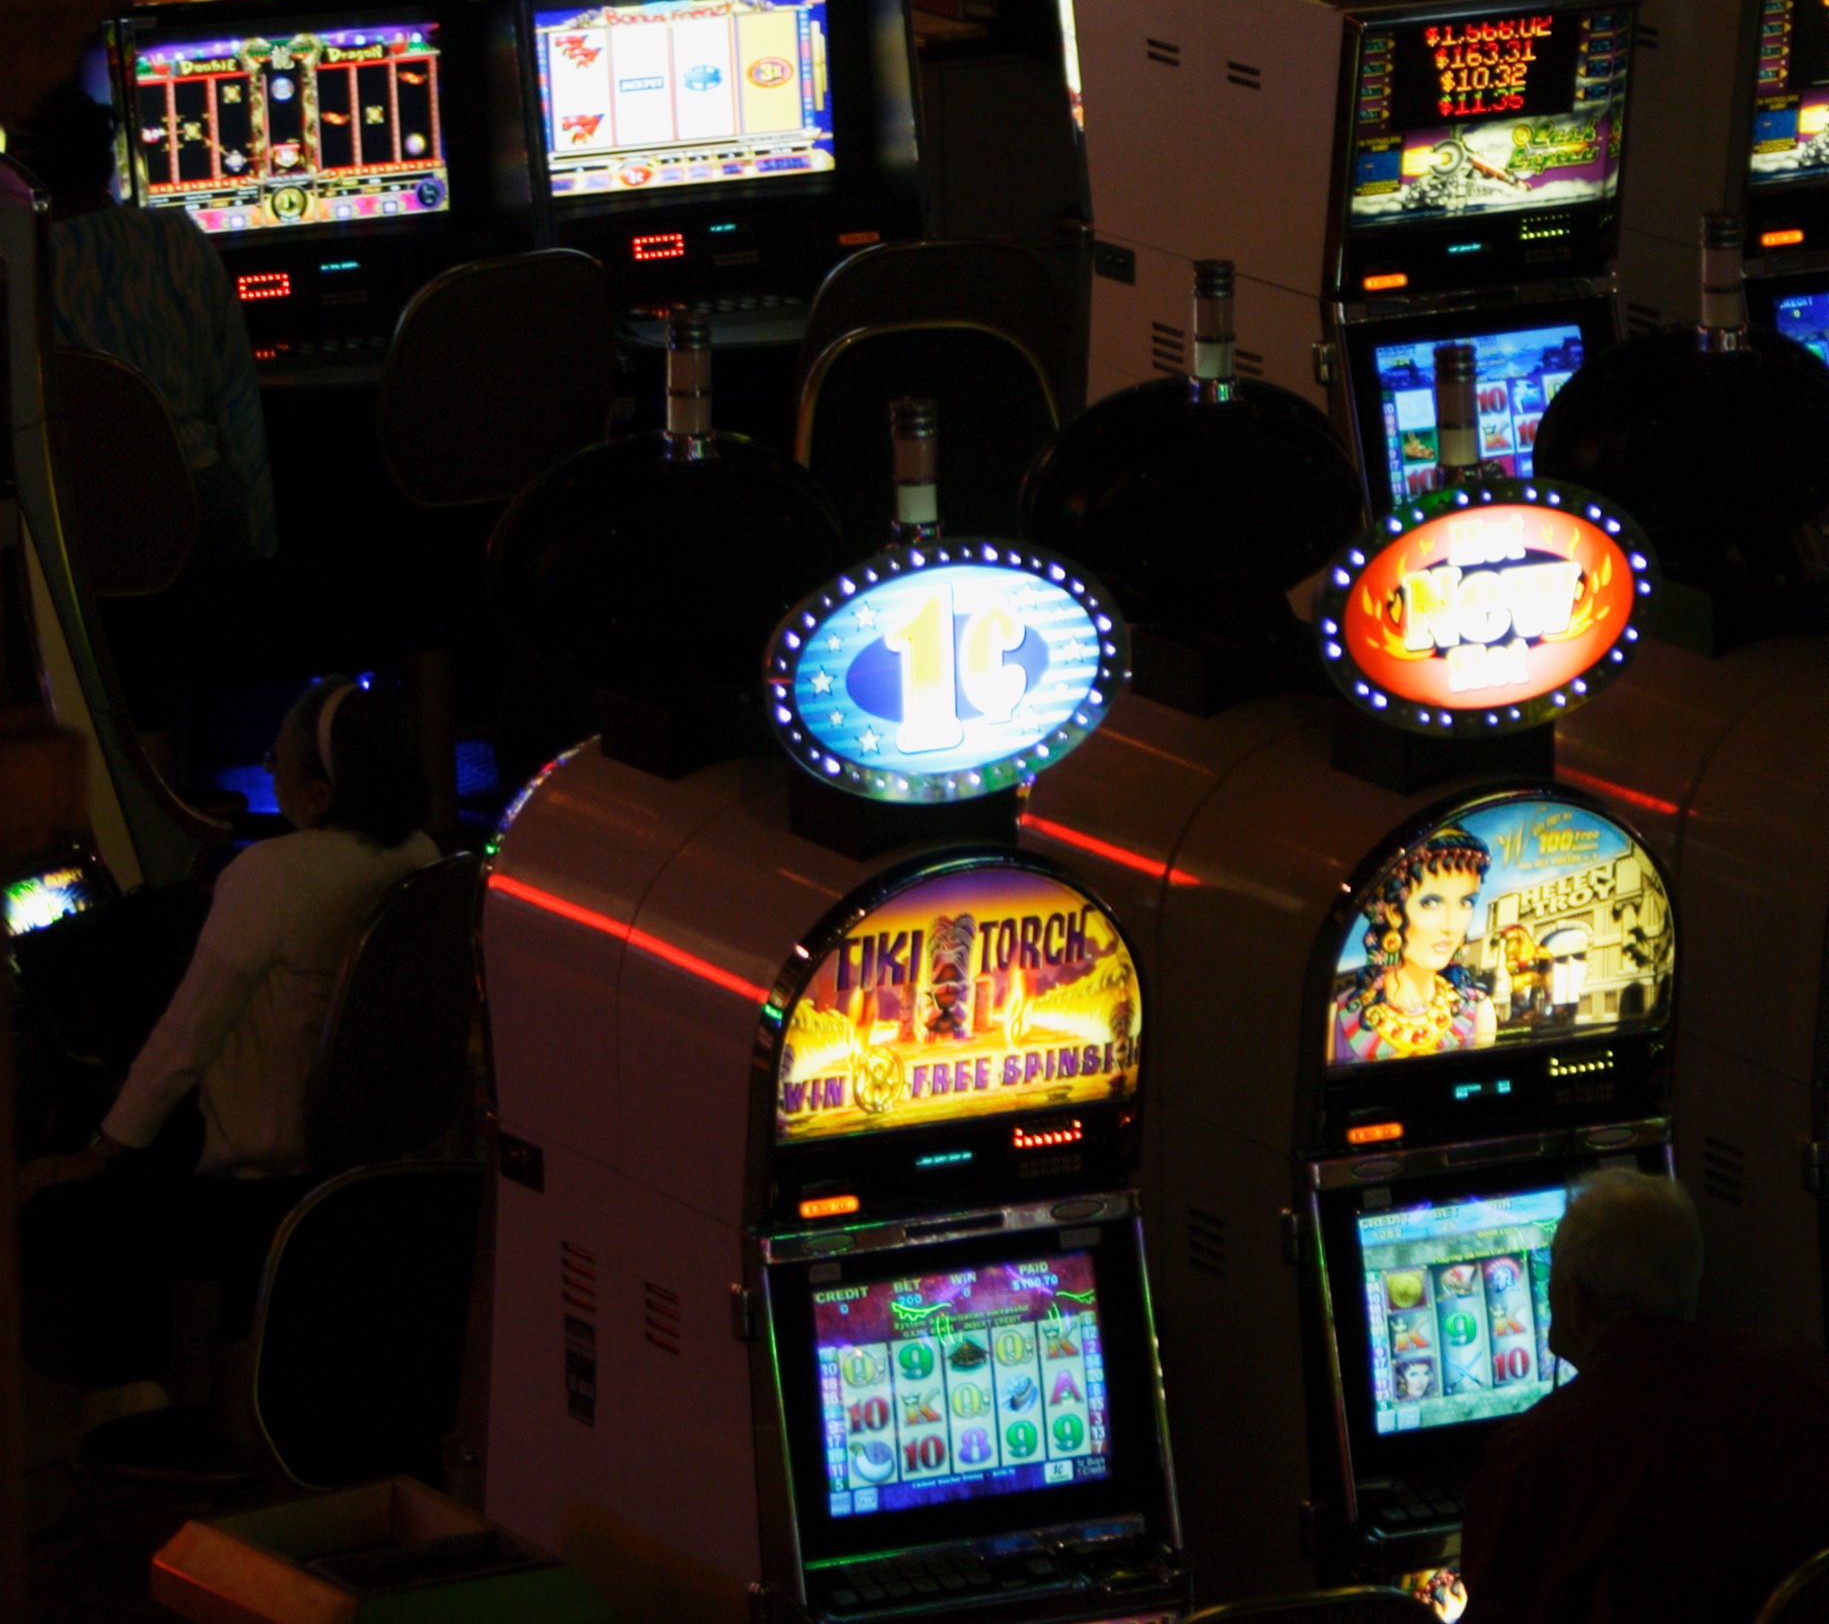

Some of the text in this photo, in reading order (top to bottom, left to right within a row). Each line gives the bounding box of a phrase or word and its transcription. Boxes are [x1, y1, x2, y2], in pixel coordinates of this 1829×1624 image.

[1432, 40, 1536, 70] $163.31
[1439, 63, 1528, 93] $10.32
[1437, 87, 1525, 117] $11.35
[1539, 832, 1574, 854] 100
[1519, 859, 1616, 906] HELEN
[1530, 884, 1617, 918] TROY
[836, 909, 1094, 990] TIKI TORCH
[782, 1054, 993, 1113] WIN FREE
[816, 1283, 871, 1305] CREDIT
[1493, 1346, 1532, 1383] 10
[843, 1394, 946, 1473] 10 10
